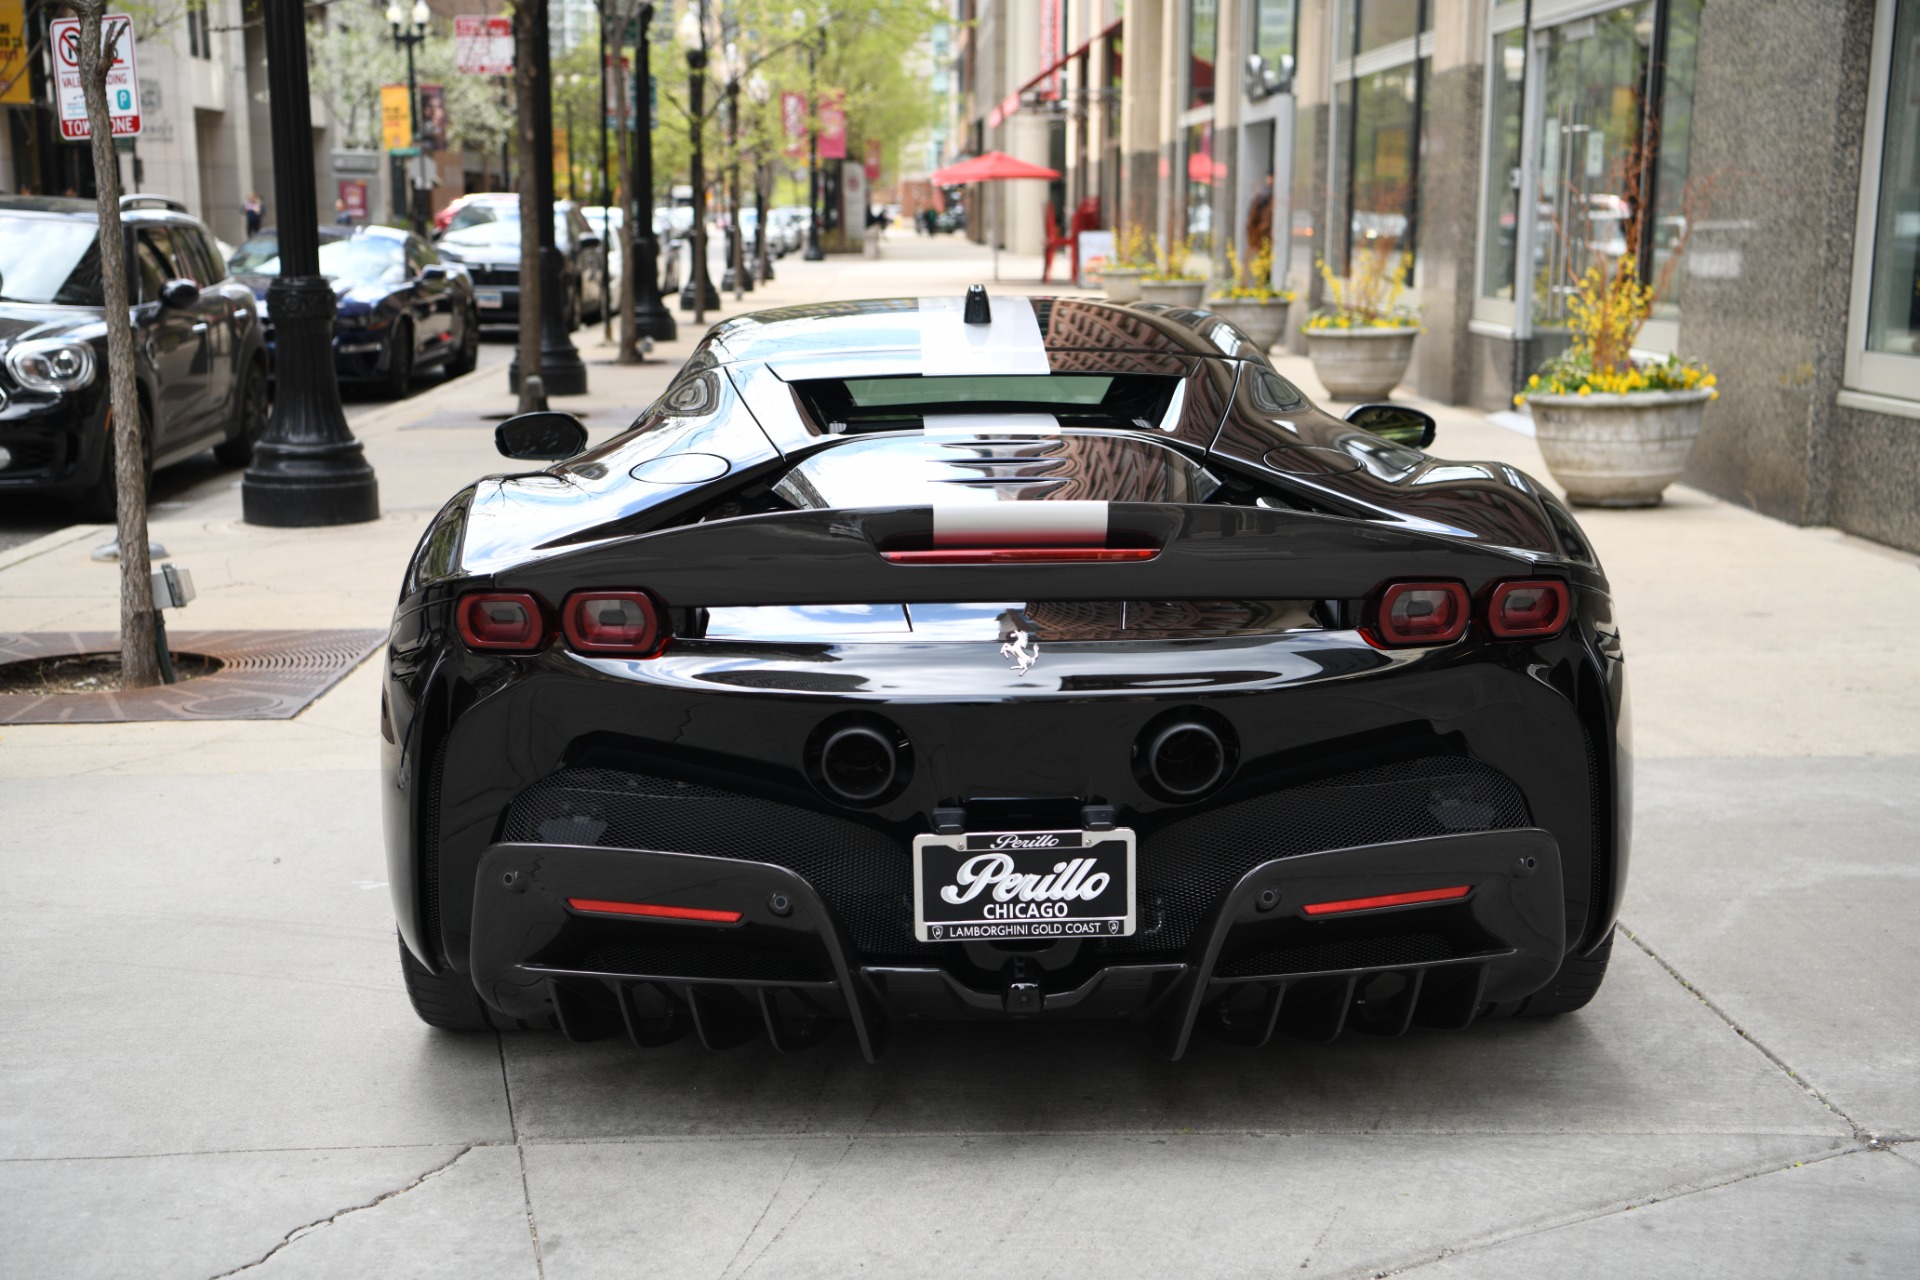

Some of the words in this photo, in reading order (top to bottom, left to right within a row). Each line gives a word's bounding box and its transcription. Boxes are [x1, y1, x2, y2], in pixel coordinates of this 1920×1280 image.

[990, 834, 1059, 848] Perillo
[940, 853, 1110, 904] Perillo
[983, 902, 1068, 918] CHICAGO
[949, 925, 1029, 937] LAMBORGHINI
[1031, 923, 1063, 935] GOLD
[1065, 922, 1101, 934] COAST
